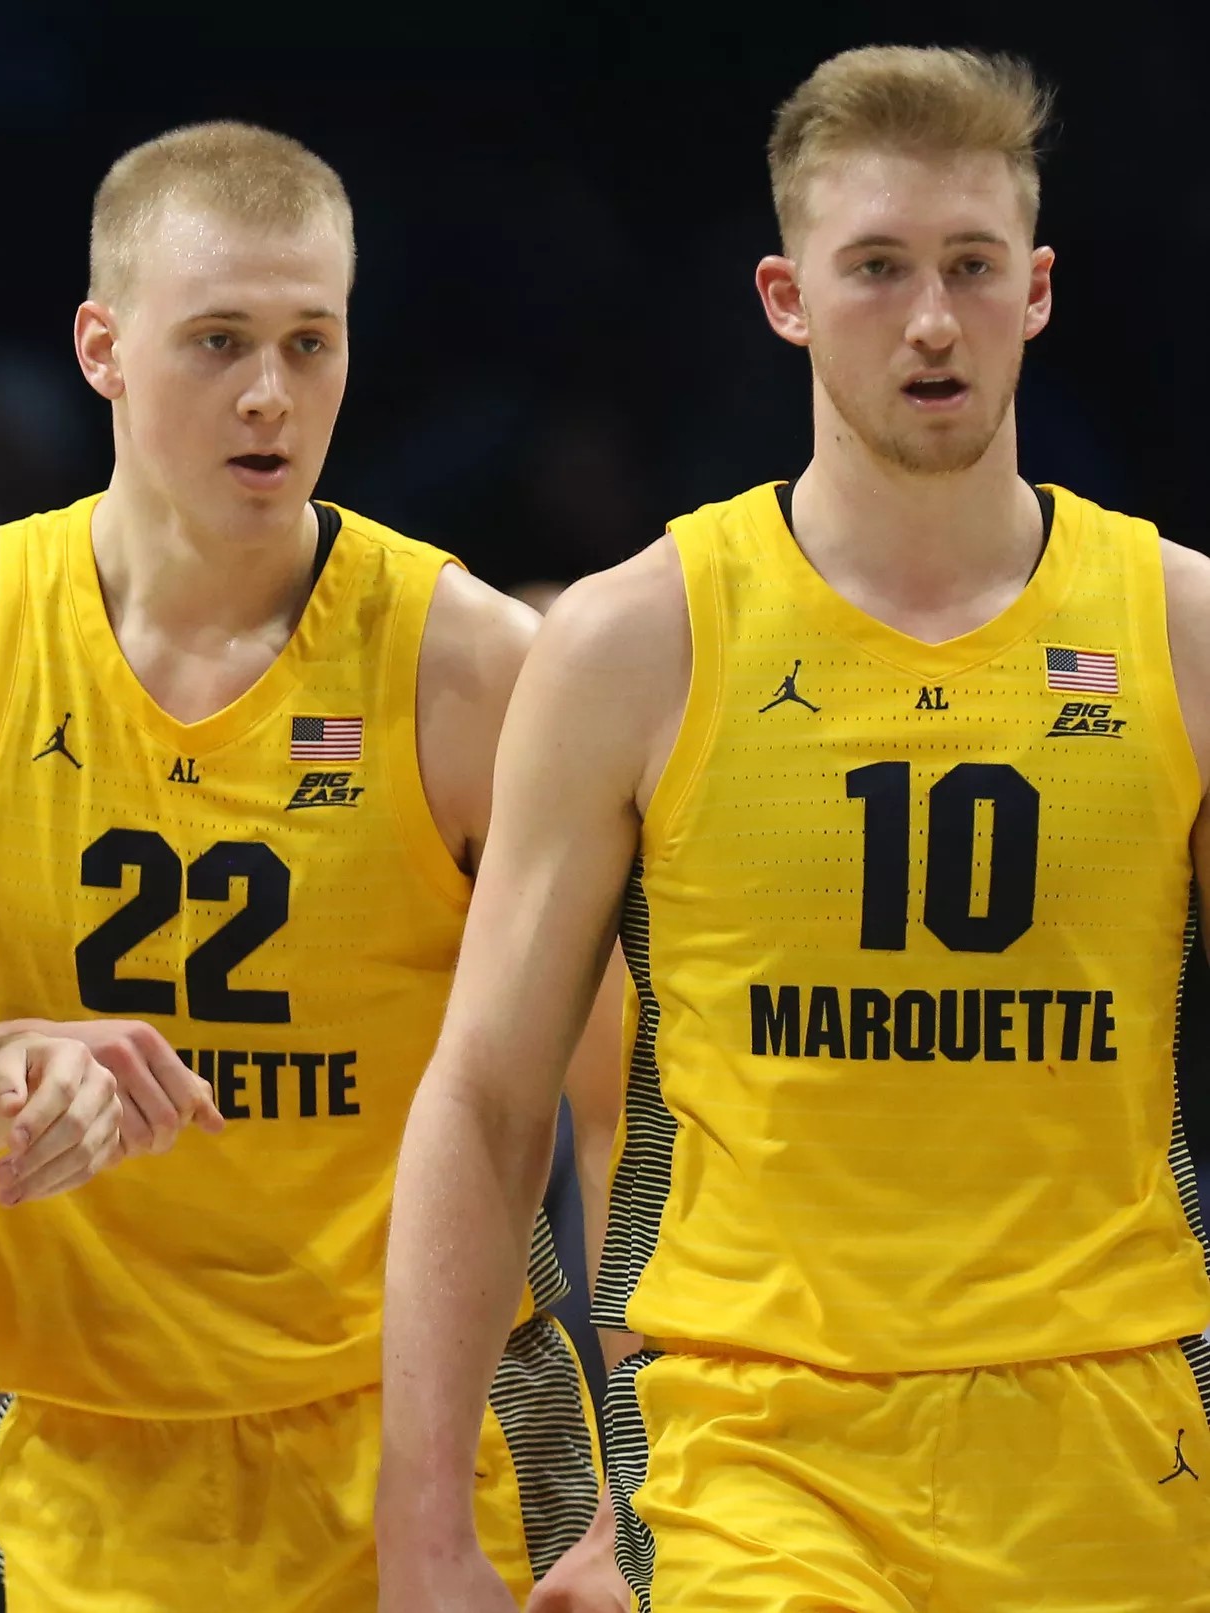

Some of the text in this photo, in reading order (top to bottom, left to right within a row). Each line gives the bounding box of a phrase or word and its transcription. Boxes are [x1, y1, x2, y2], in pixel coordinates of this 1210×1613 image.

[915, 687, 949, 710] AL
[1059, 702, 1112, 717] BIG
[1052, 717, 1127, 732] EAST
[167, 757, 200, 784] AL
[299, 772, 352, 787] BIG
[290, 788, 365, 802] EAST
[845, 762, 1040, 954] 10
[75, 828, 291, 1024] 22
[750, 985, 1117, 1062] MARQUETTE
